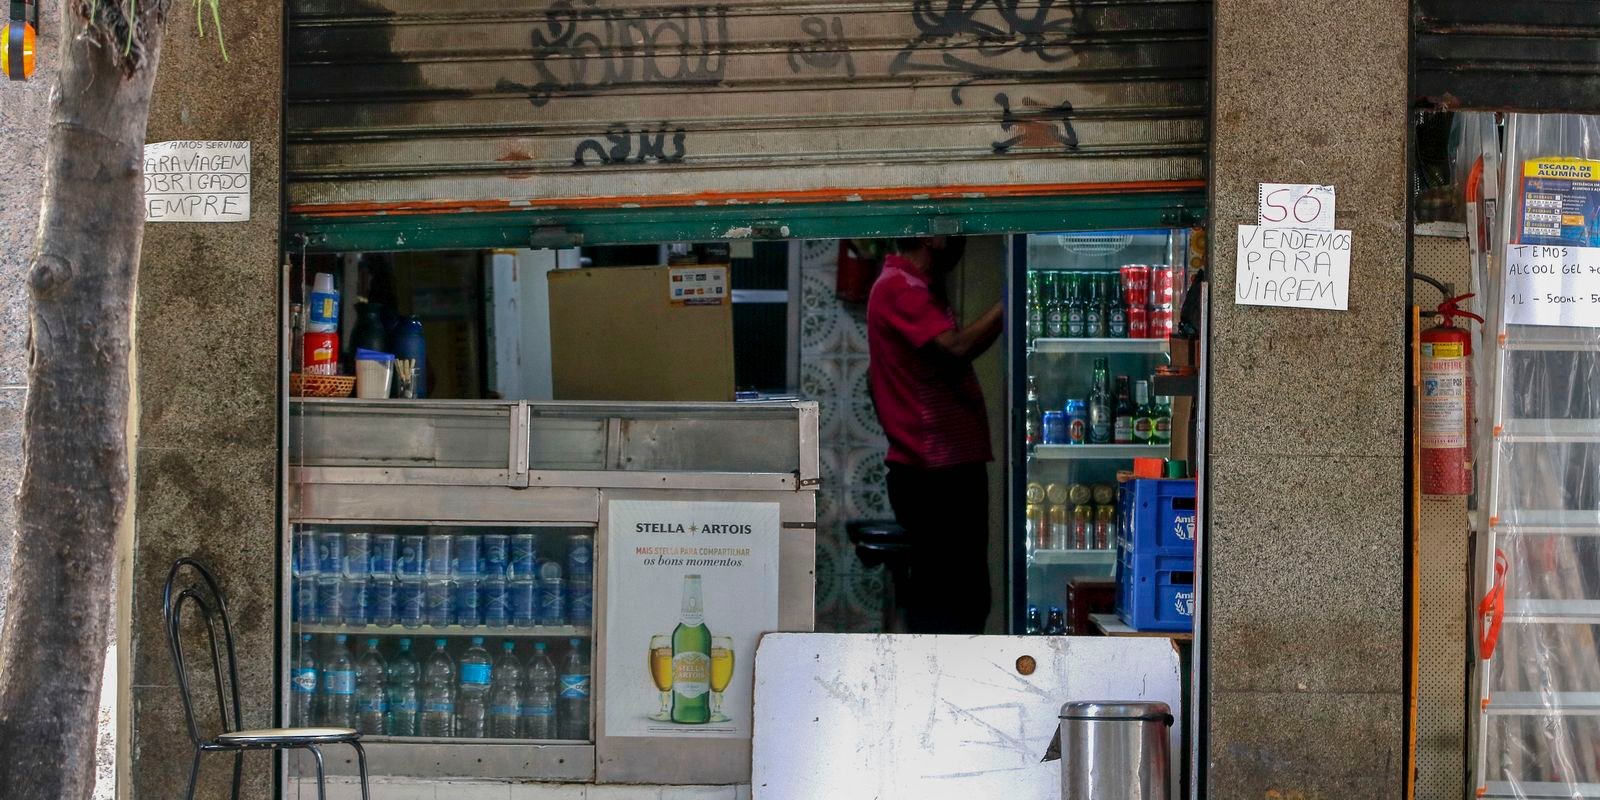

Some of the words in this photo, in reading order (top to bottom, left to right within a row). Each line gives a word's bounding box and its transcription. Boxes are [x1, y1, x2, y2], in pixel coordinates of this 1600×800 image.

[206, 141, 249, 150] SERVINDO
[144, 156, 182, 173] ARA
[1538, 163, 1576, 171] ESCADA
[1537, 169, 1592, 178] ALUMÍNIO
[144, 195, 242, 218] EMPRE
[1262, 187, 1322, 223] SÓ
[1241, 226, 1350, 251] VENDEMOS
[1513, 246, 1568, 258] TEMOS
[1247, 250, 1332, 277] PARA
[1509, 263, 1555, 275] ALCOOL
[1562, 264, 1582, 274] GEL
[636, 522, 685, 533] STELLA
[701, 524, 752, 534] ARTOIS
[636, 546, 653, 555] MAIS
[654, 546, 678, 555] STELLA
[680, 547, 698, 555] PARA
[699, 547, 751, 556] COMPARTILHAR
[657, 555, 683, 566] bons
